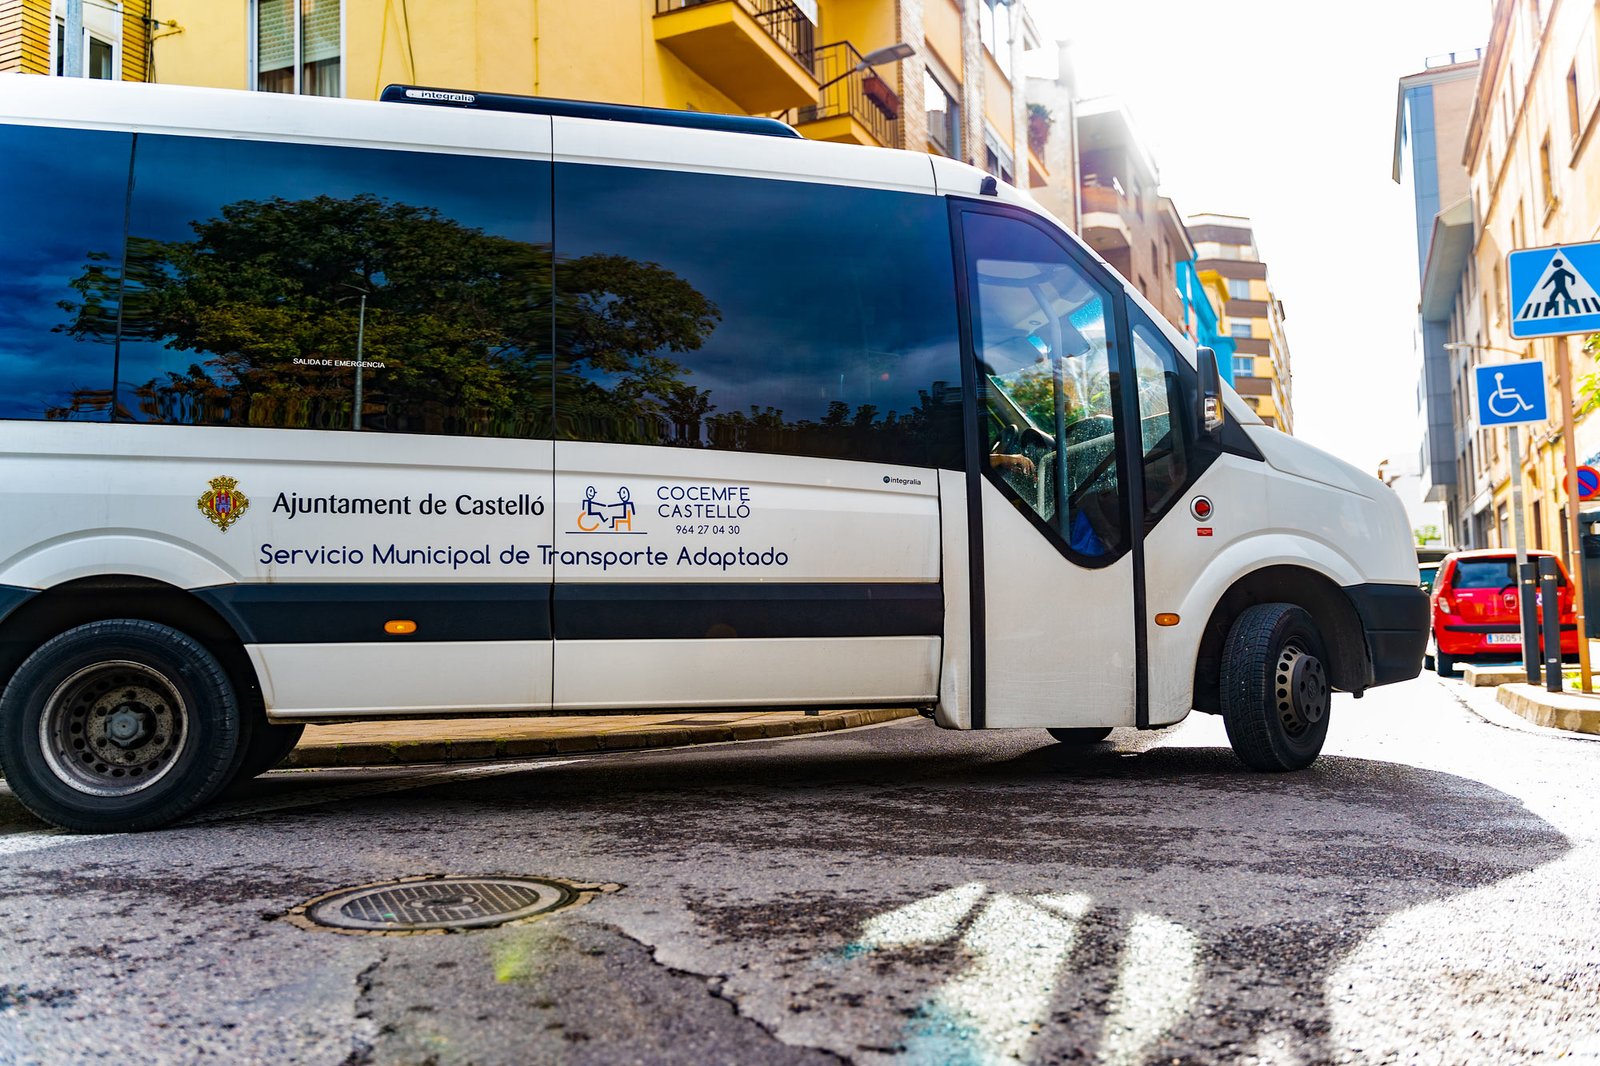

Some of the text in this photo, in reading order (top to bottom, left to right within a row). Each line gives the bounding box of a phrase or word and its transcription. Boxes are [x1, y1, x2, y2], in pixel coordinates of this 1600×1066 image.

[421, 90, 475, 103] integralia
[292, 357, 386, 369] SALIDA DE EMERGENCIA
[890, 476, 922, 486] integralia
[656, 486, 750, 502] COCEMFE
[271, 492, 545, 520] Ajuntament de Castelló
[657, 501, 751, 519] CASTELLÓ
[675, 524, 741, 535] 964 27 04 30
[259, 543, 789, 572] Servicio Municipal de Transporte Adaptado
